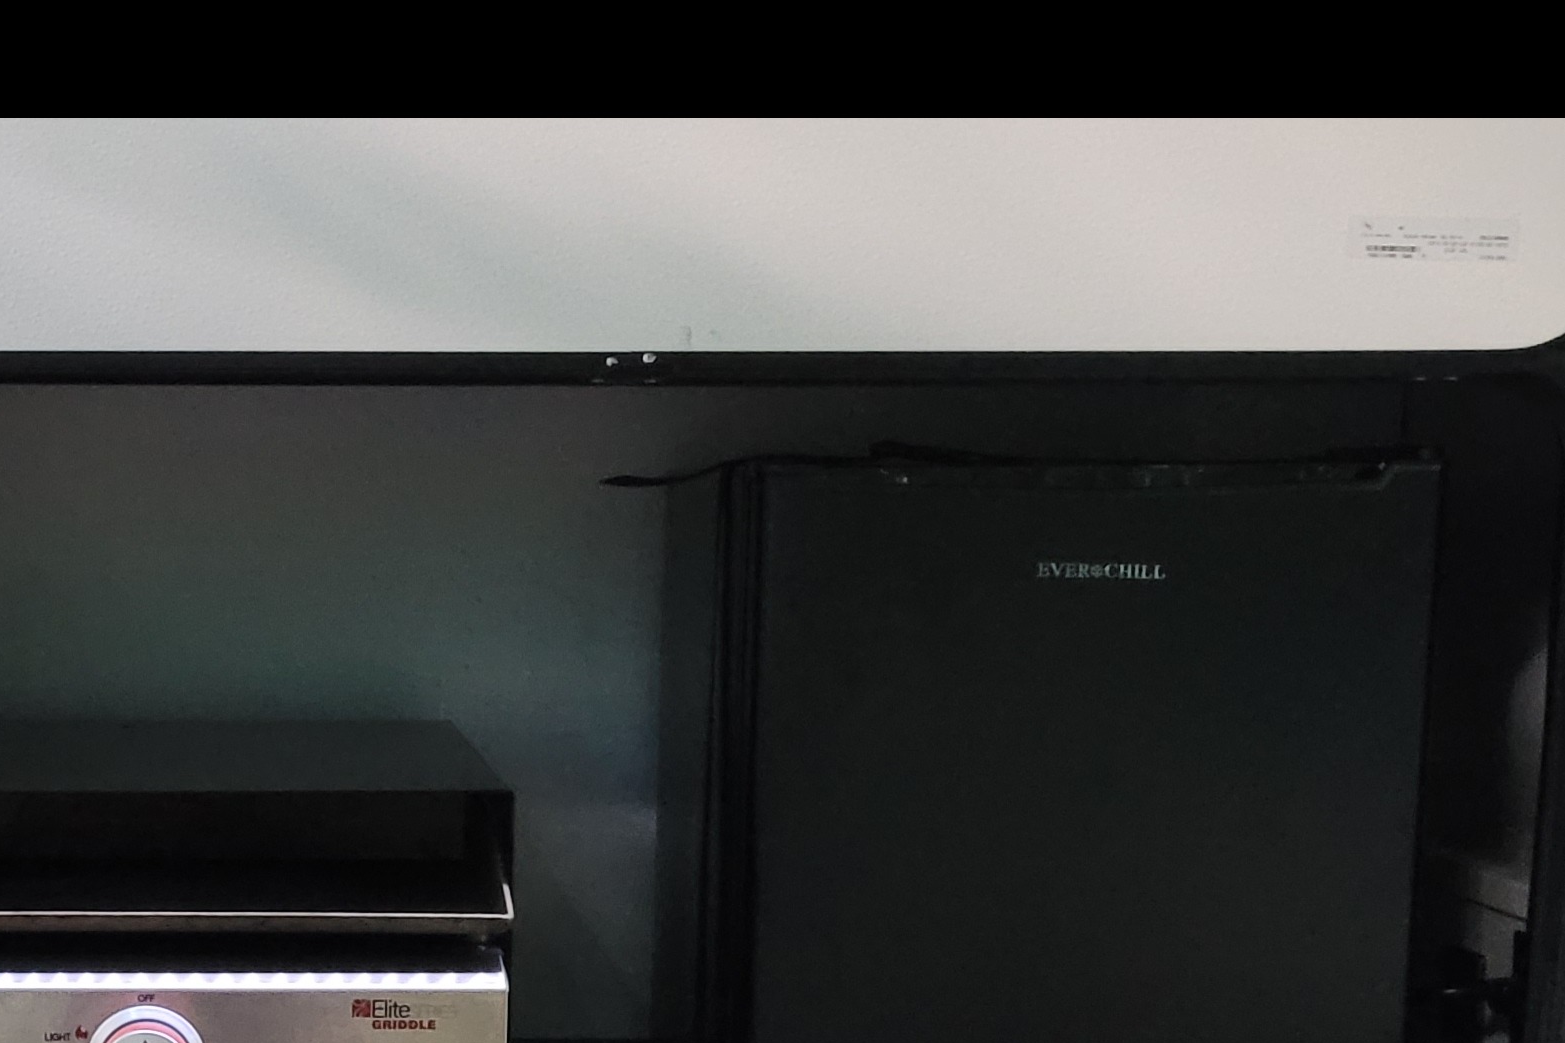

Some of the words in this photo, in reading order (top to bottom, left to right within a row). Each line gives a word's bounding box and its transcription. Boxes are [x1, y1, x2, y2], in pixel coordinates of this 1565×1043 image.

[137, 993, 155, 1003] OFF
[372, 999, 411, 1018] Elite
[372, 1020, 436, 1030] GRIDDLE
[44, 1032, 71, 1042] LIGHT
